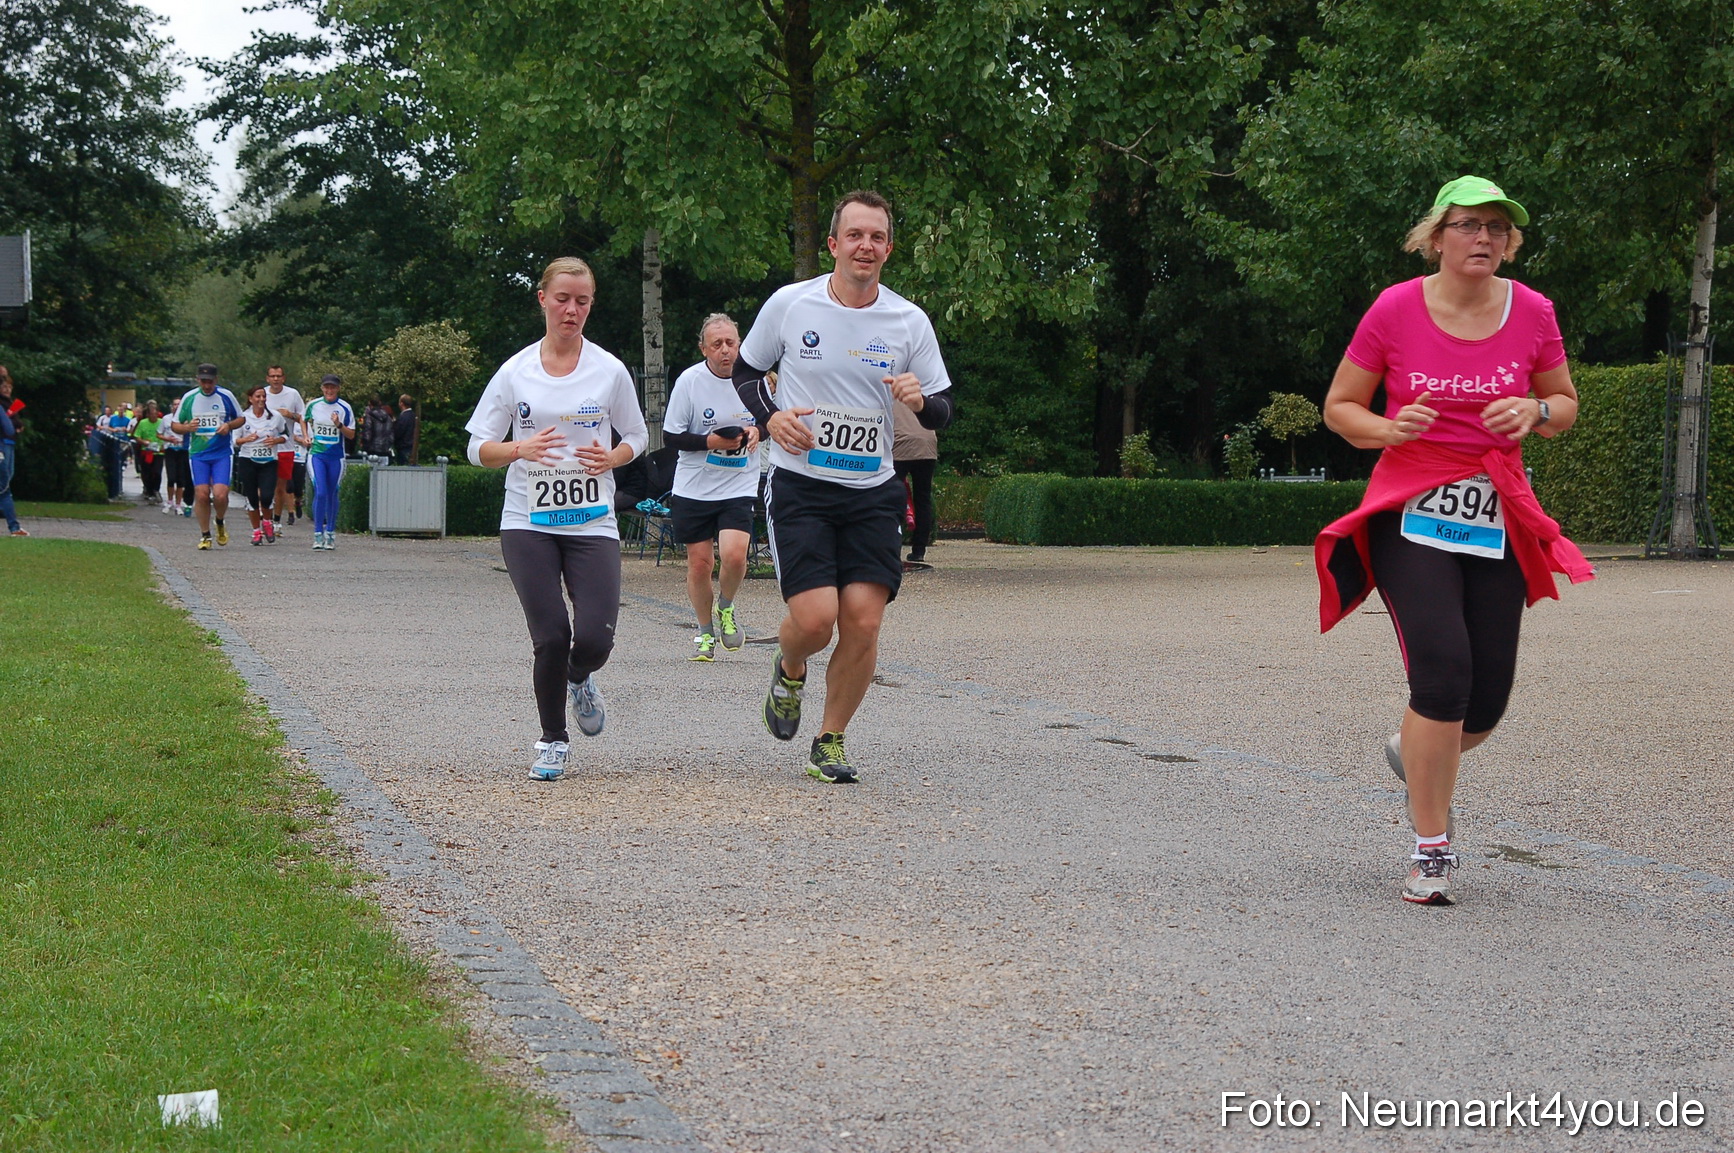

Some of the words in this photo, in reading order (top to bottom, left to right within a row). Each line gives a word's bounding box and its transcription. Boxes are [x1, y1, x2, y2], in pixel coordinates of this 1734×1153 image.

[1408, 372, 1501, 396] Perfekt
[197, 417, 218, 427] 2815
[816, 408, 842, 420] PARTL
[843, 413, 876, 424] Neumarkt
[317, 426, 338, 436] 2814
[818, 421, 878, 453] 3028
[825, 455, 865, 470] Andreas
[528, 469, 553, 478] PARTL
[555, 467, 588, 476] Neumar
[535, 478, 600, 508] 2860
[1416, 484, 1499, 523] 2594
[548, 511, 592, 524] Melanie
[1435, 523, 1470, 542] Karin
